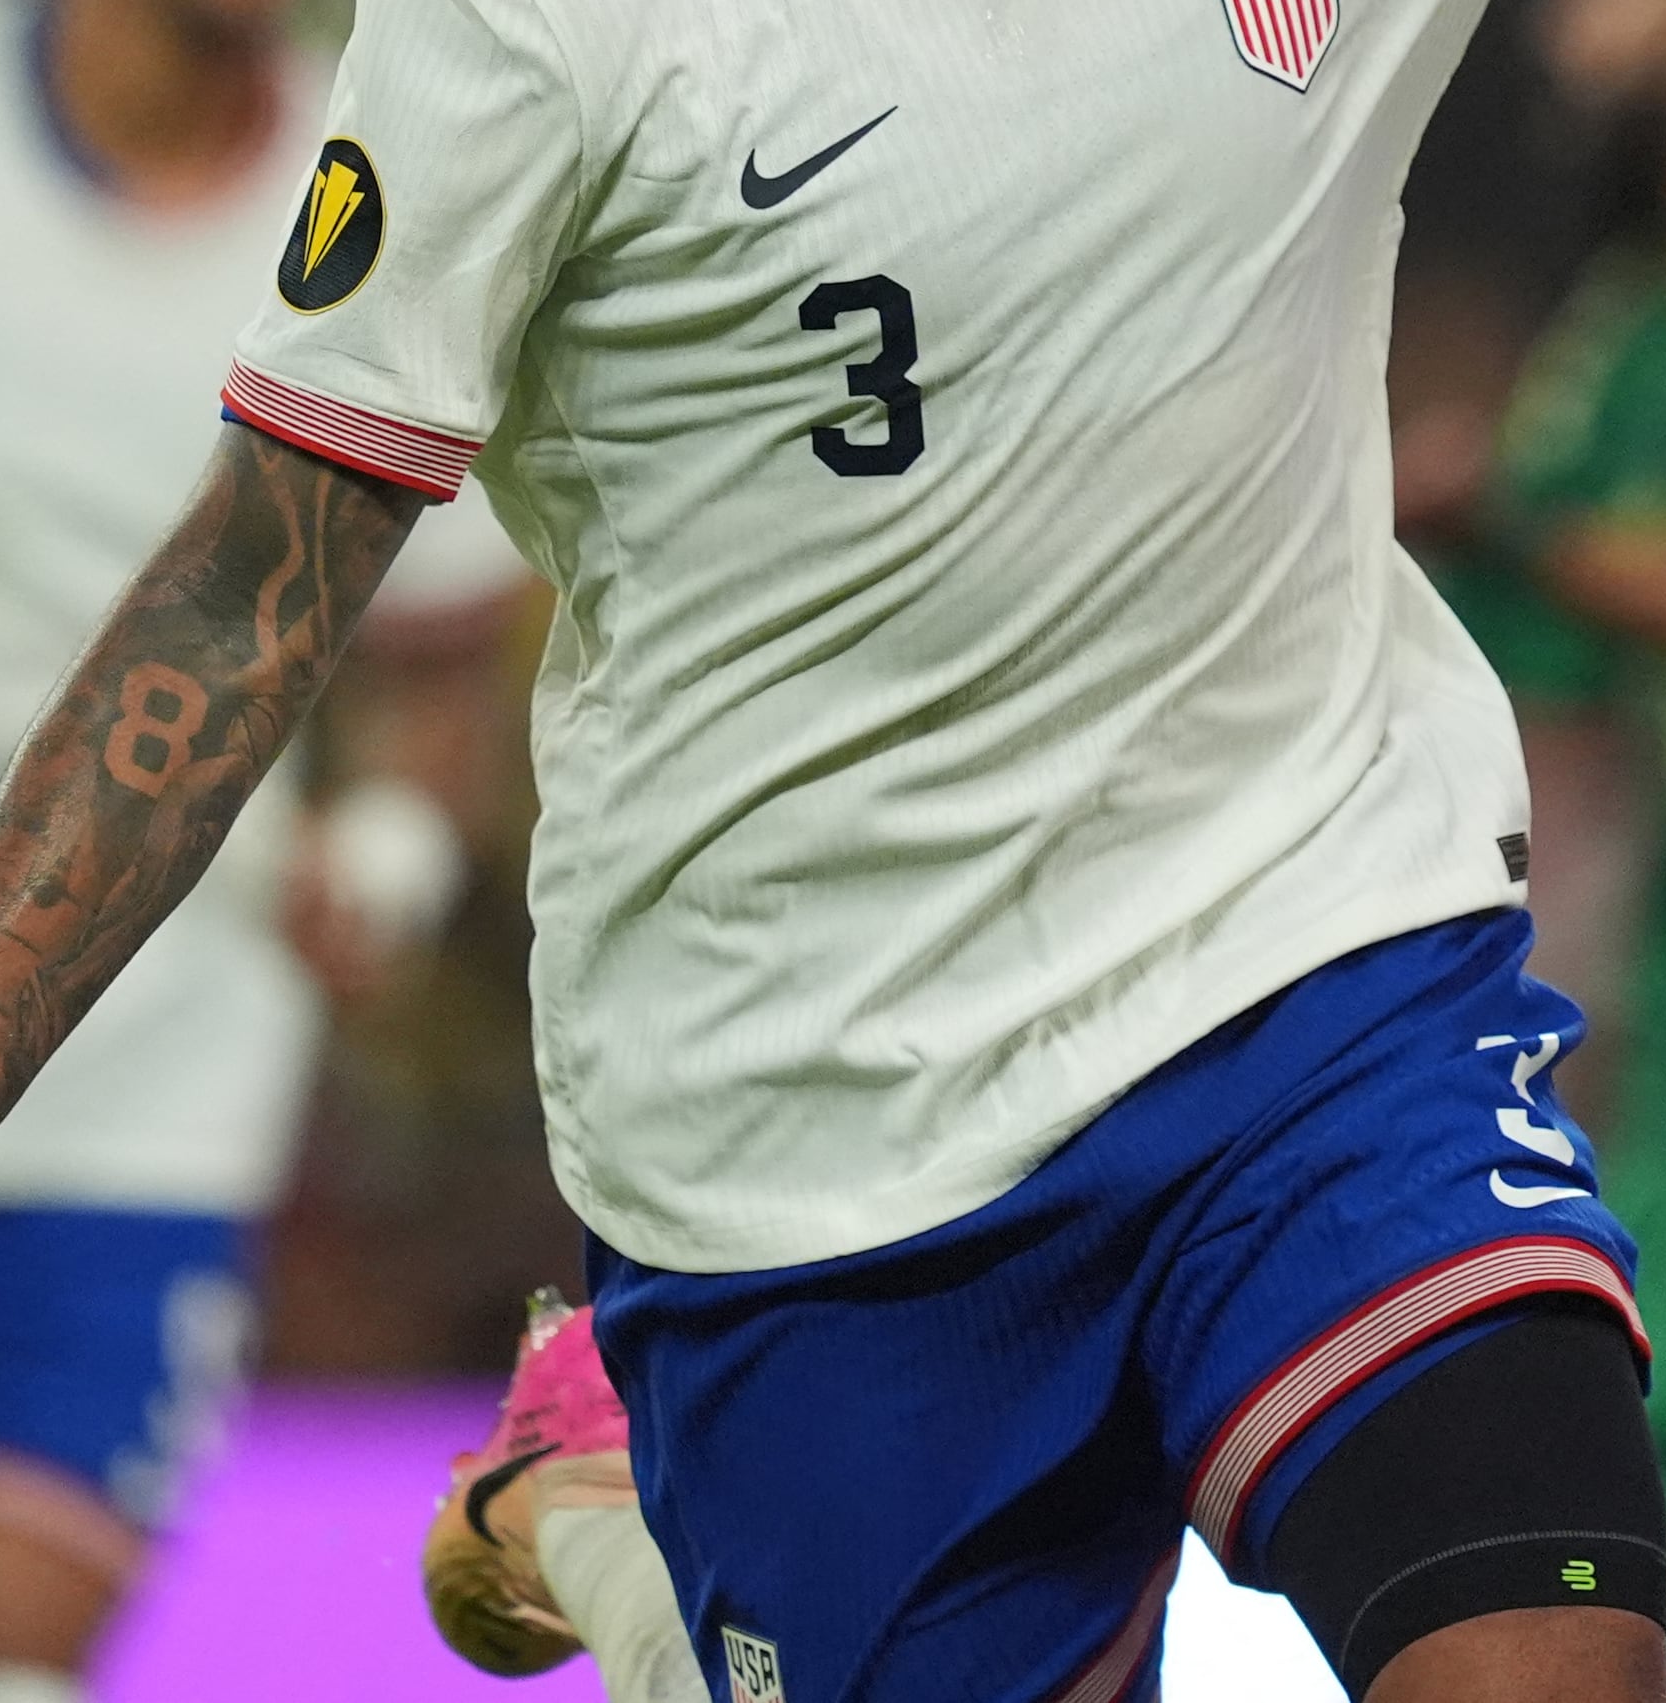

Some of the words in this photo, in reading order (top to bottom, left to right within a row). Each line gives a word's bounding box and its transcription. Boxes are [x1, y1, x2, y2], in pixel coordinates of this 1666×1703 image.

[798, 273, 925, 478] 3
[104, 659, 210, 799] 8
[726, 1634, 777, 1697] USA
